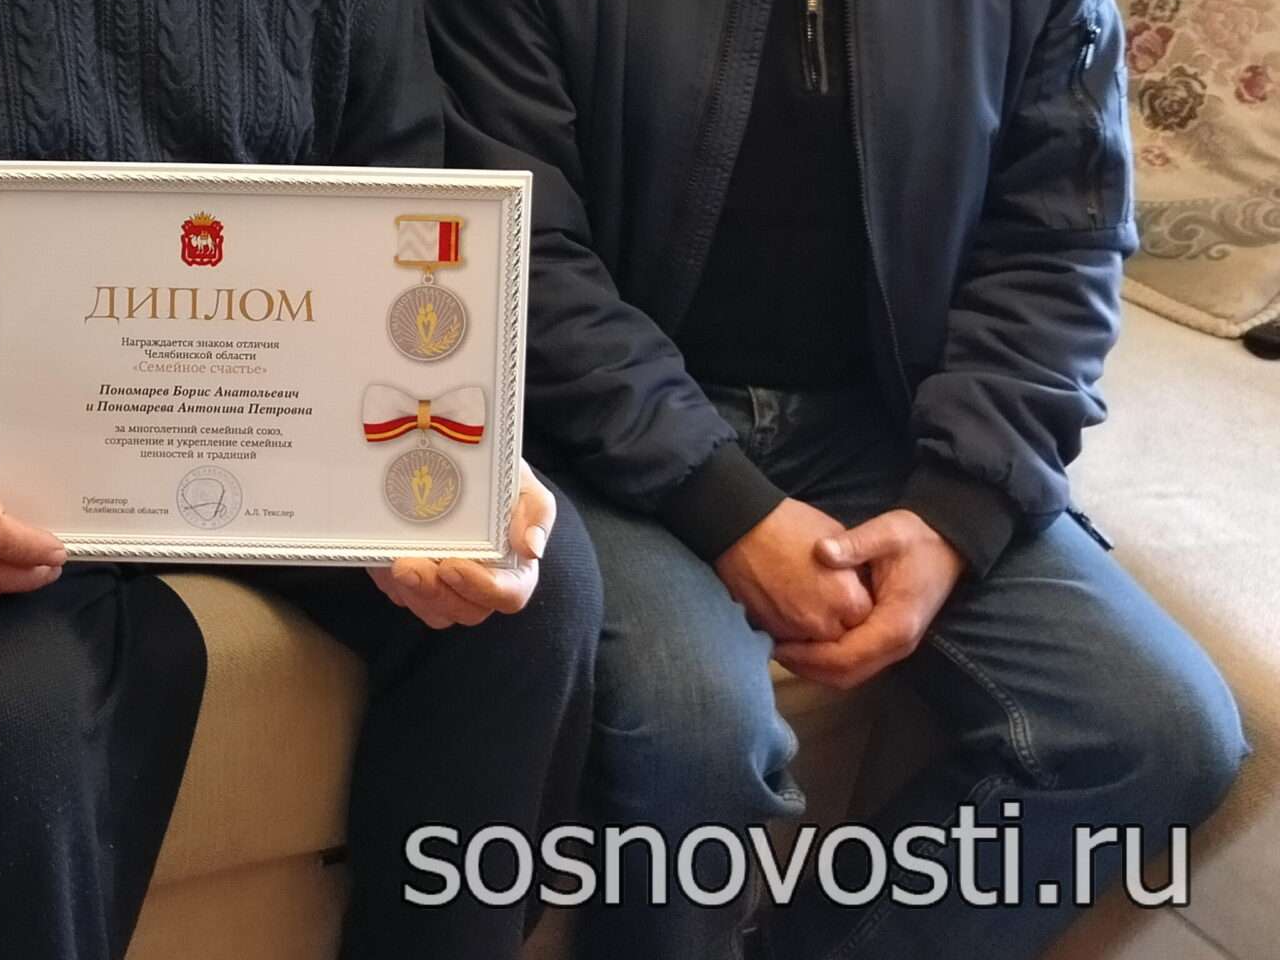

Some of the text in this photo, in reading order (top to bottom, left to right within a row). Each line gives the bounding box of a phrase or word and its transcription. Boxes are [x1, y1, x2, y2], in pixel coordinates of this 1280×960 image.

[84, 286, 315, 326] ДИПЛОМ
[121, 337, 279, 349] Награждается знаком отличия
[144, 350, 256, 360] Челябинской области
[133, 361, 267, 374] «Семейное счастье»
[99, 385, 299, 398] Пономарев Борис Анатольевич
[86, 401, 313, 417] и Пономарева Антонина Петровна
[128, 424, 197, 434] многолетний
[200, 425, 253, 434] семейный
[105, 437, 292, 450] сохранение и укрепление семейных
[140, 449, 194, 459] ценностей
[207, 450, 256, 460] традиций
[82, 497, 128, 507] Губернатор
[82, 505, 135, 514] Челябинской
[263, 509, 294, 517] Текслер
